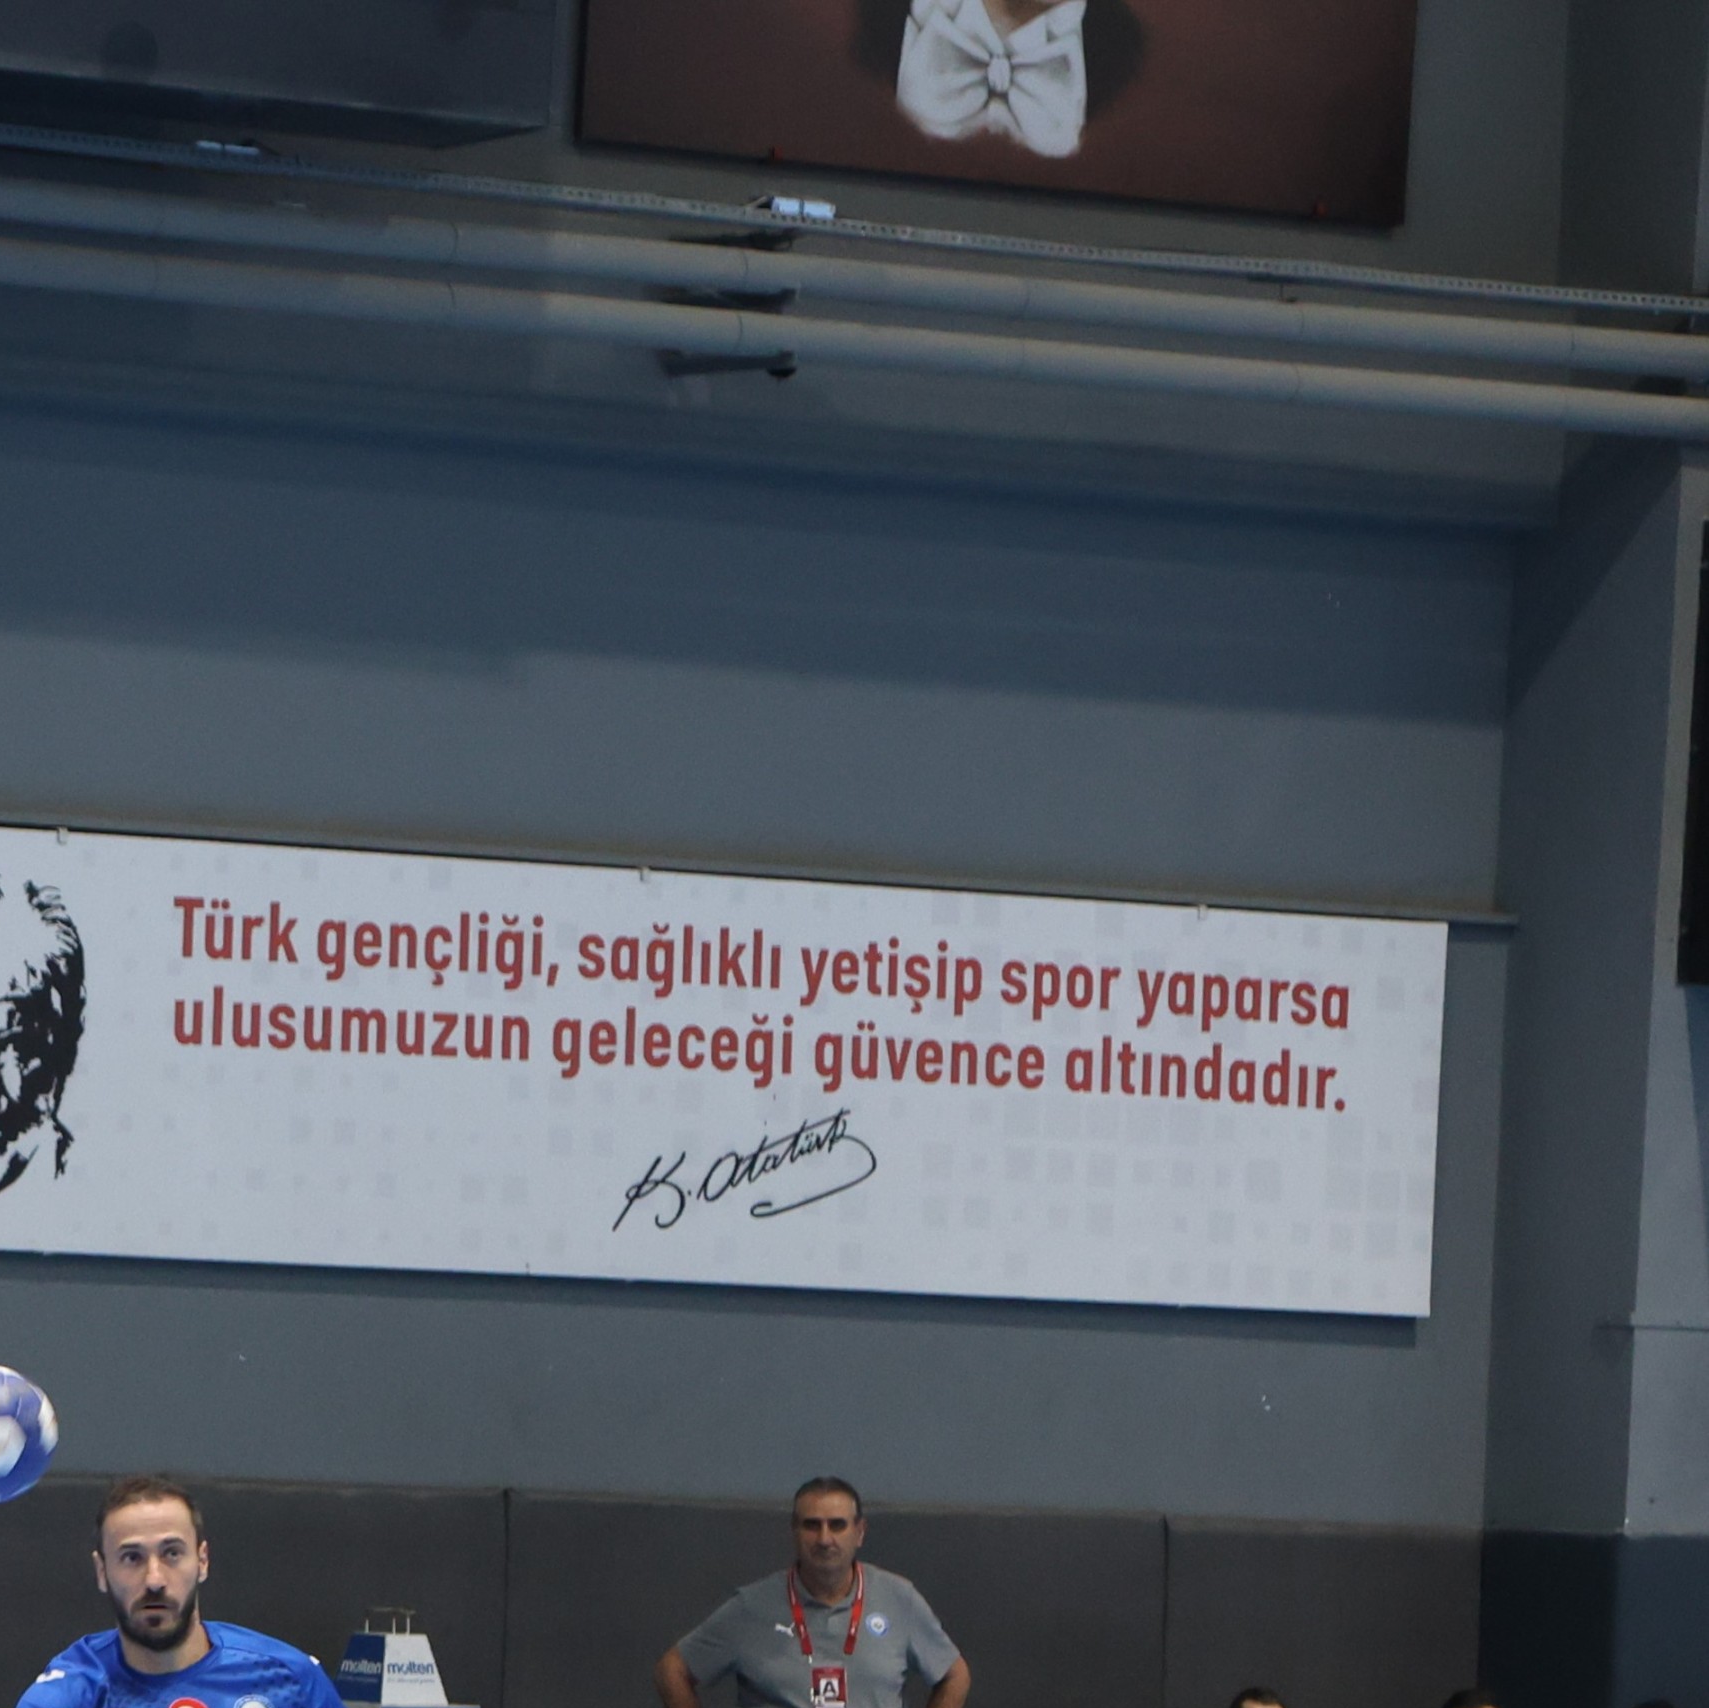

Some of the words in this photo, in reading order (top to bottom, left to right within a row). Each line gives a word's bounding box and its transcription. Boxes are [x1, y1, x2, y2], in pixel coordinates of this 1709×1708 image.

[174, 897, 296, 962] Türk
[318, 913, 558, 991] gençliği,
[579, 924, 781, 999] sağlıklı
[801, 939, 983, 1016] yetişip
[1002, 960, 1120, 1020] spor
[1137, 970, 1349, 1032] yaparsa
[174, 987, 529, 1060] ulusumuzun
[553, 1008, 793, 1088] geleceği
[815, 1023, 1045, 1093] güvence
[1066, 1037, 1345, 1111] altındadır.
[386, 1660, 434, 1676] molten
